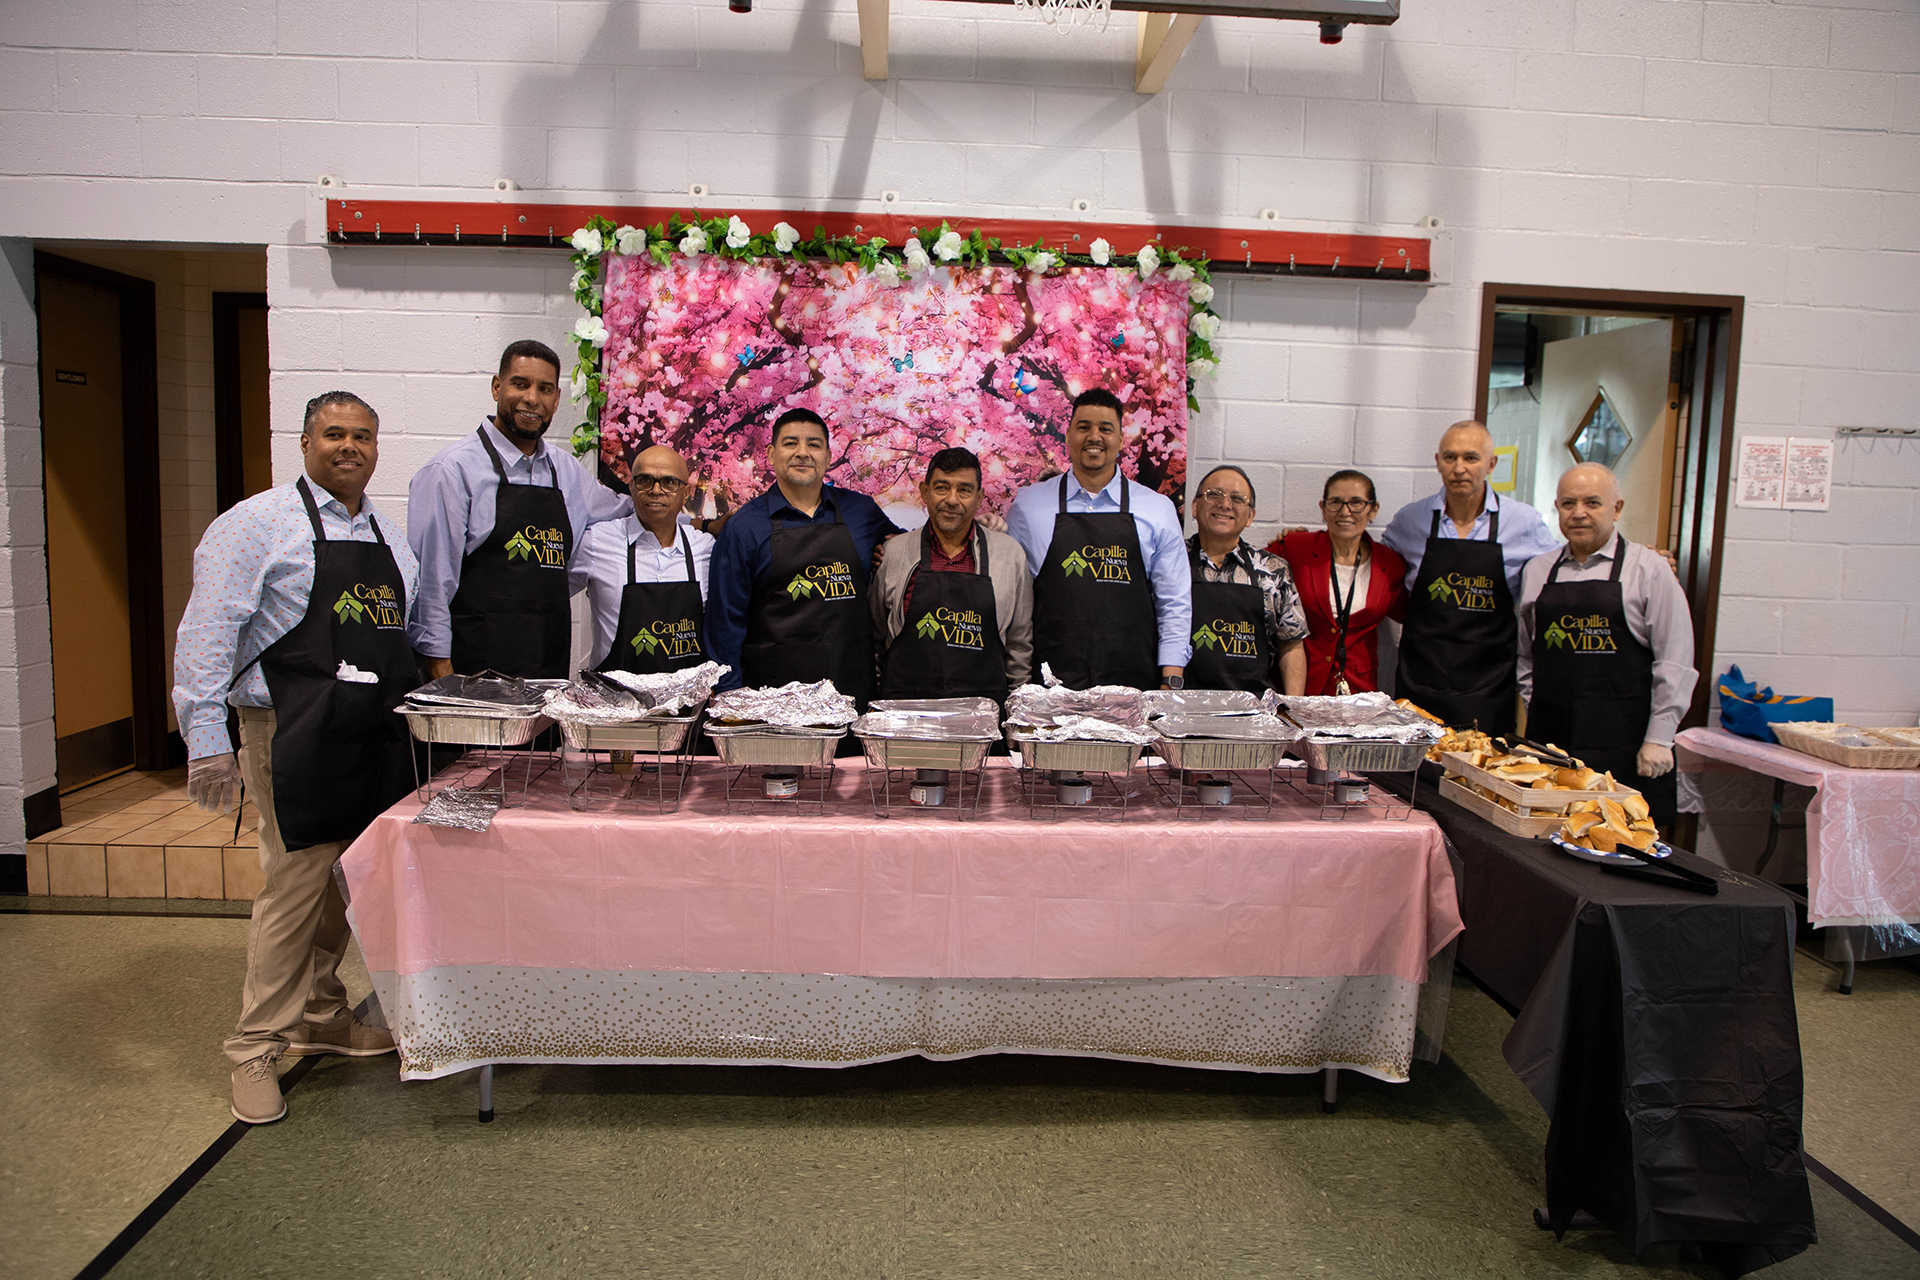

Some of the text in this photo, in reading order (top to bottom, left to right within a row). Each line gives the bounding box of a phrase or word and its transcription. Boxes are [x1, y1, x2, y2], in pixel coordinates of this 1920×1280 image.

[57, 372, 85, 383] GENTLEMEN
[1749, 446, 1781, 454] CHOKING
[525, 525, 564, 544] Capilla
[546, 541, 564, 550] Nueva
[1082, 545, 1128, 560] Capilla
[531, 544, 565, 566] VIDA
[1105, 557, 1128, 566] Nueva
[805, 561, 850, 578] Capilla
[830, 574, 852, 582] Nueva
[1088, 561, 1132, 581] VIDA
[813, 580, 857, 598] VIDA
[1447, 572, 1494, 589] Capilla
[353, 583, 396, 603] Capilla
[1452, 588, 1496, 609] VIDA
[1469, 587, 1494, 596] Nueva
[363, 604, 403, 626] VIDA
[936, 606, 982, 624] Capilla
[1560, 614, 1610, 631] Capilla
[651, 618, 695, 636] Capilla
[958, 622, 982, 632] Nueva
[1212, 618, 1255, 635] Capilla
[1583, 627, 1611, 635] Nueva
[675, 631, 696, 640] Nueva
[940, 624, 985, 647] VIDA
[1235, 632, 1256, 641] Nueva
[1566, 632, 1618, 650] VIDA
[658, 637, 701, 656] VIDA
[1218, 635, 1258, 656] VIDA
